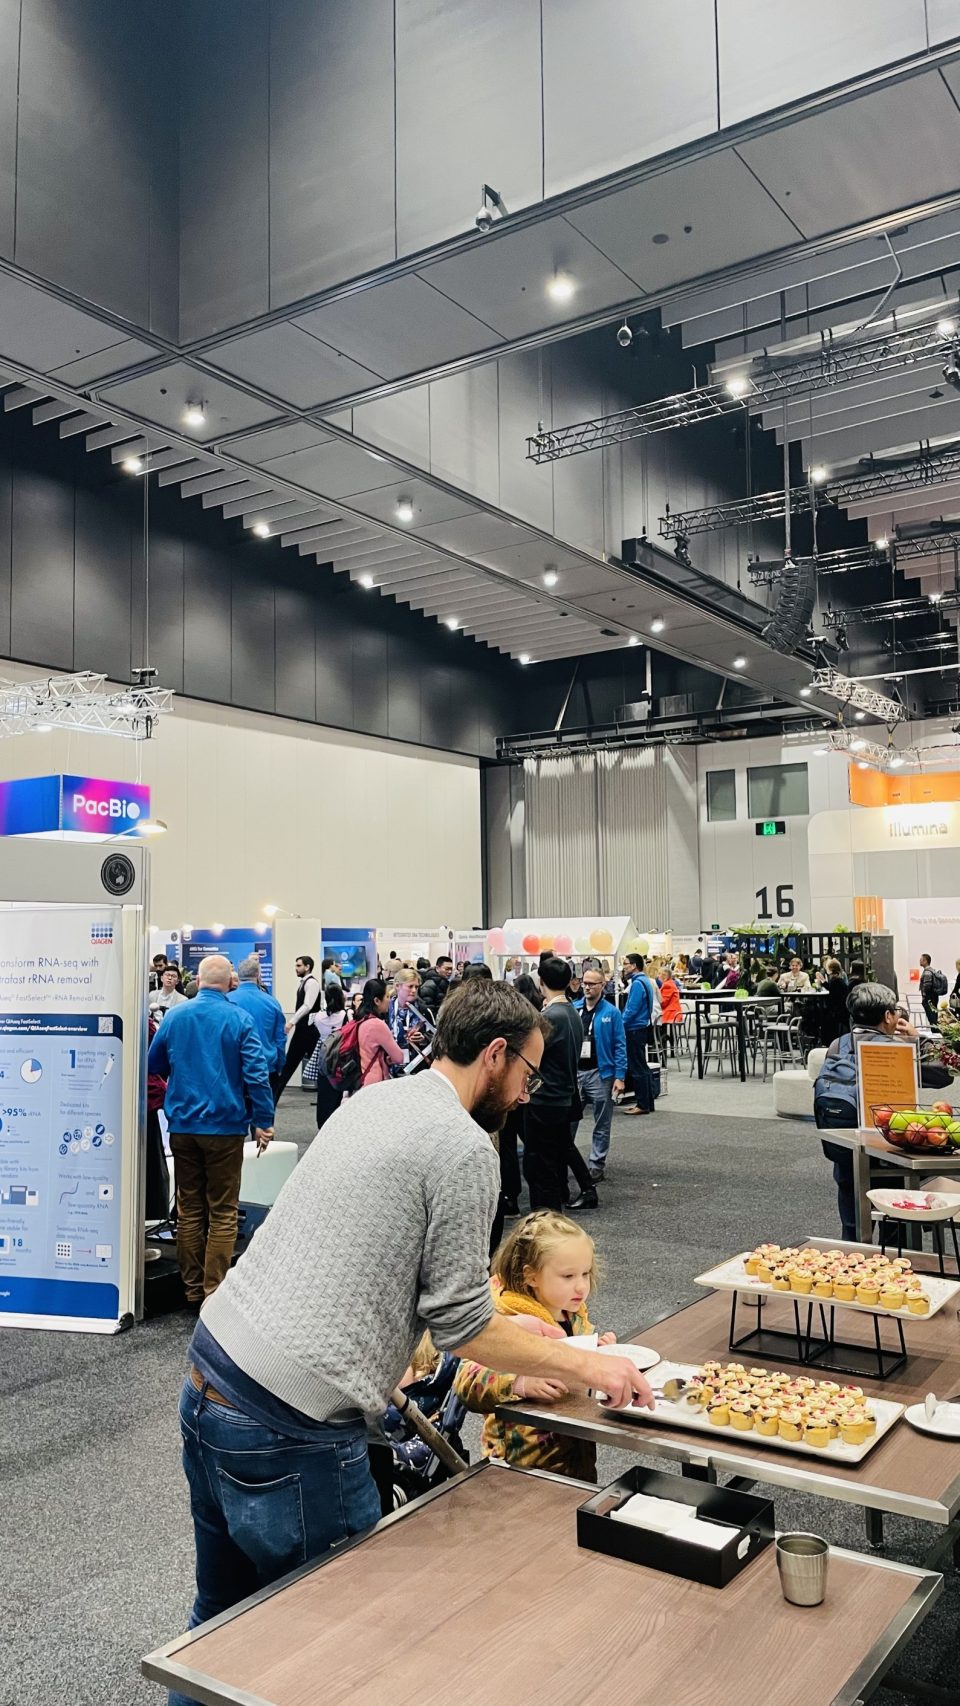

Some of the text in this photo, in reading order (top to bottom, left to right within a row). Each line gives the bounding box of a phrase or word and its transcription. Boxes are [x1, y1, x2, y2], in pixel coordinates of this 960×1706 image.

[73, 794, 140, 819] PacBio
[755, 884, 794, 920] 16
[38, 957, 78, 971] RNA-seq
[81, 957, 99, 968] with
[28, 974, 55, 984] rRNA
[57, 973, 93, 984] removal
[70, 1050, 76, 1068] 1
[2, 1108, 27, 1117] >95%
[12, 1238, 23, 1247] 18
